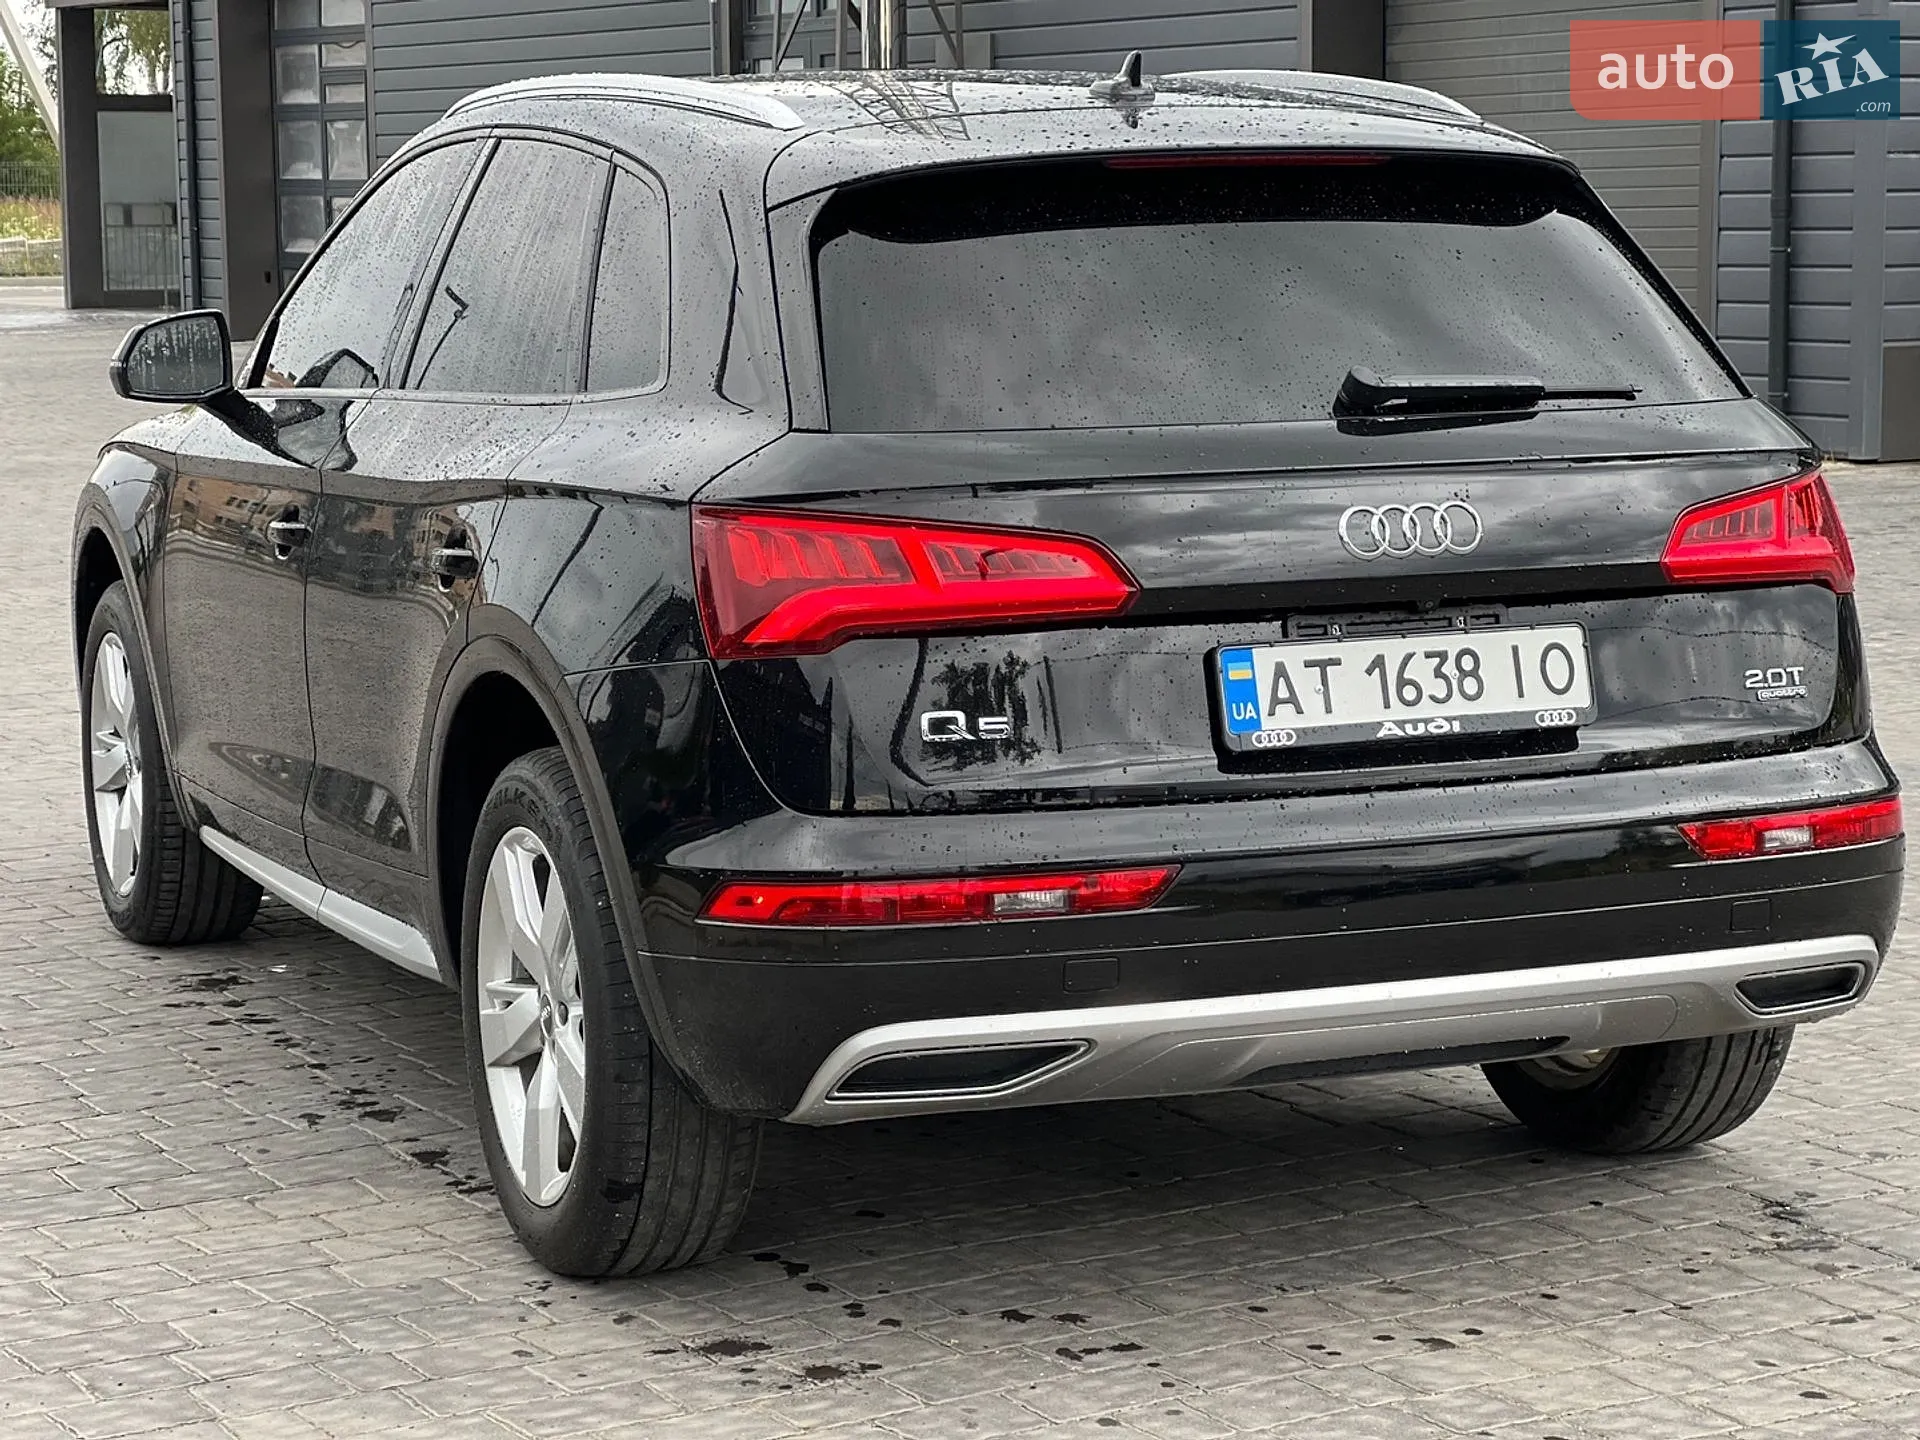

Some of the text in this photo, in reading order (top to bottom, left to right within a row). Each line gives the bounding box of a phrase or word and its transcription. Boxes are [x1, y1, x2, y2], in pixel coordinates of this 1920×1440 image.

[1267, 657, 1342, 717] AT
[1364, 647, 1485, 709] 1638
[1744, 666, 1804, 688] 2.0T
[1758, 687, 1808, 700] quattro
[1231, 702, 1258, 720] UA
[921, 710, 1010, 741] Q5
[1375, 718, 1461, 738] Audi
